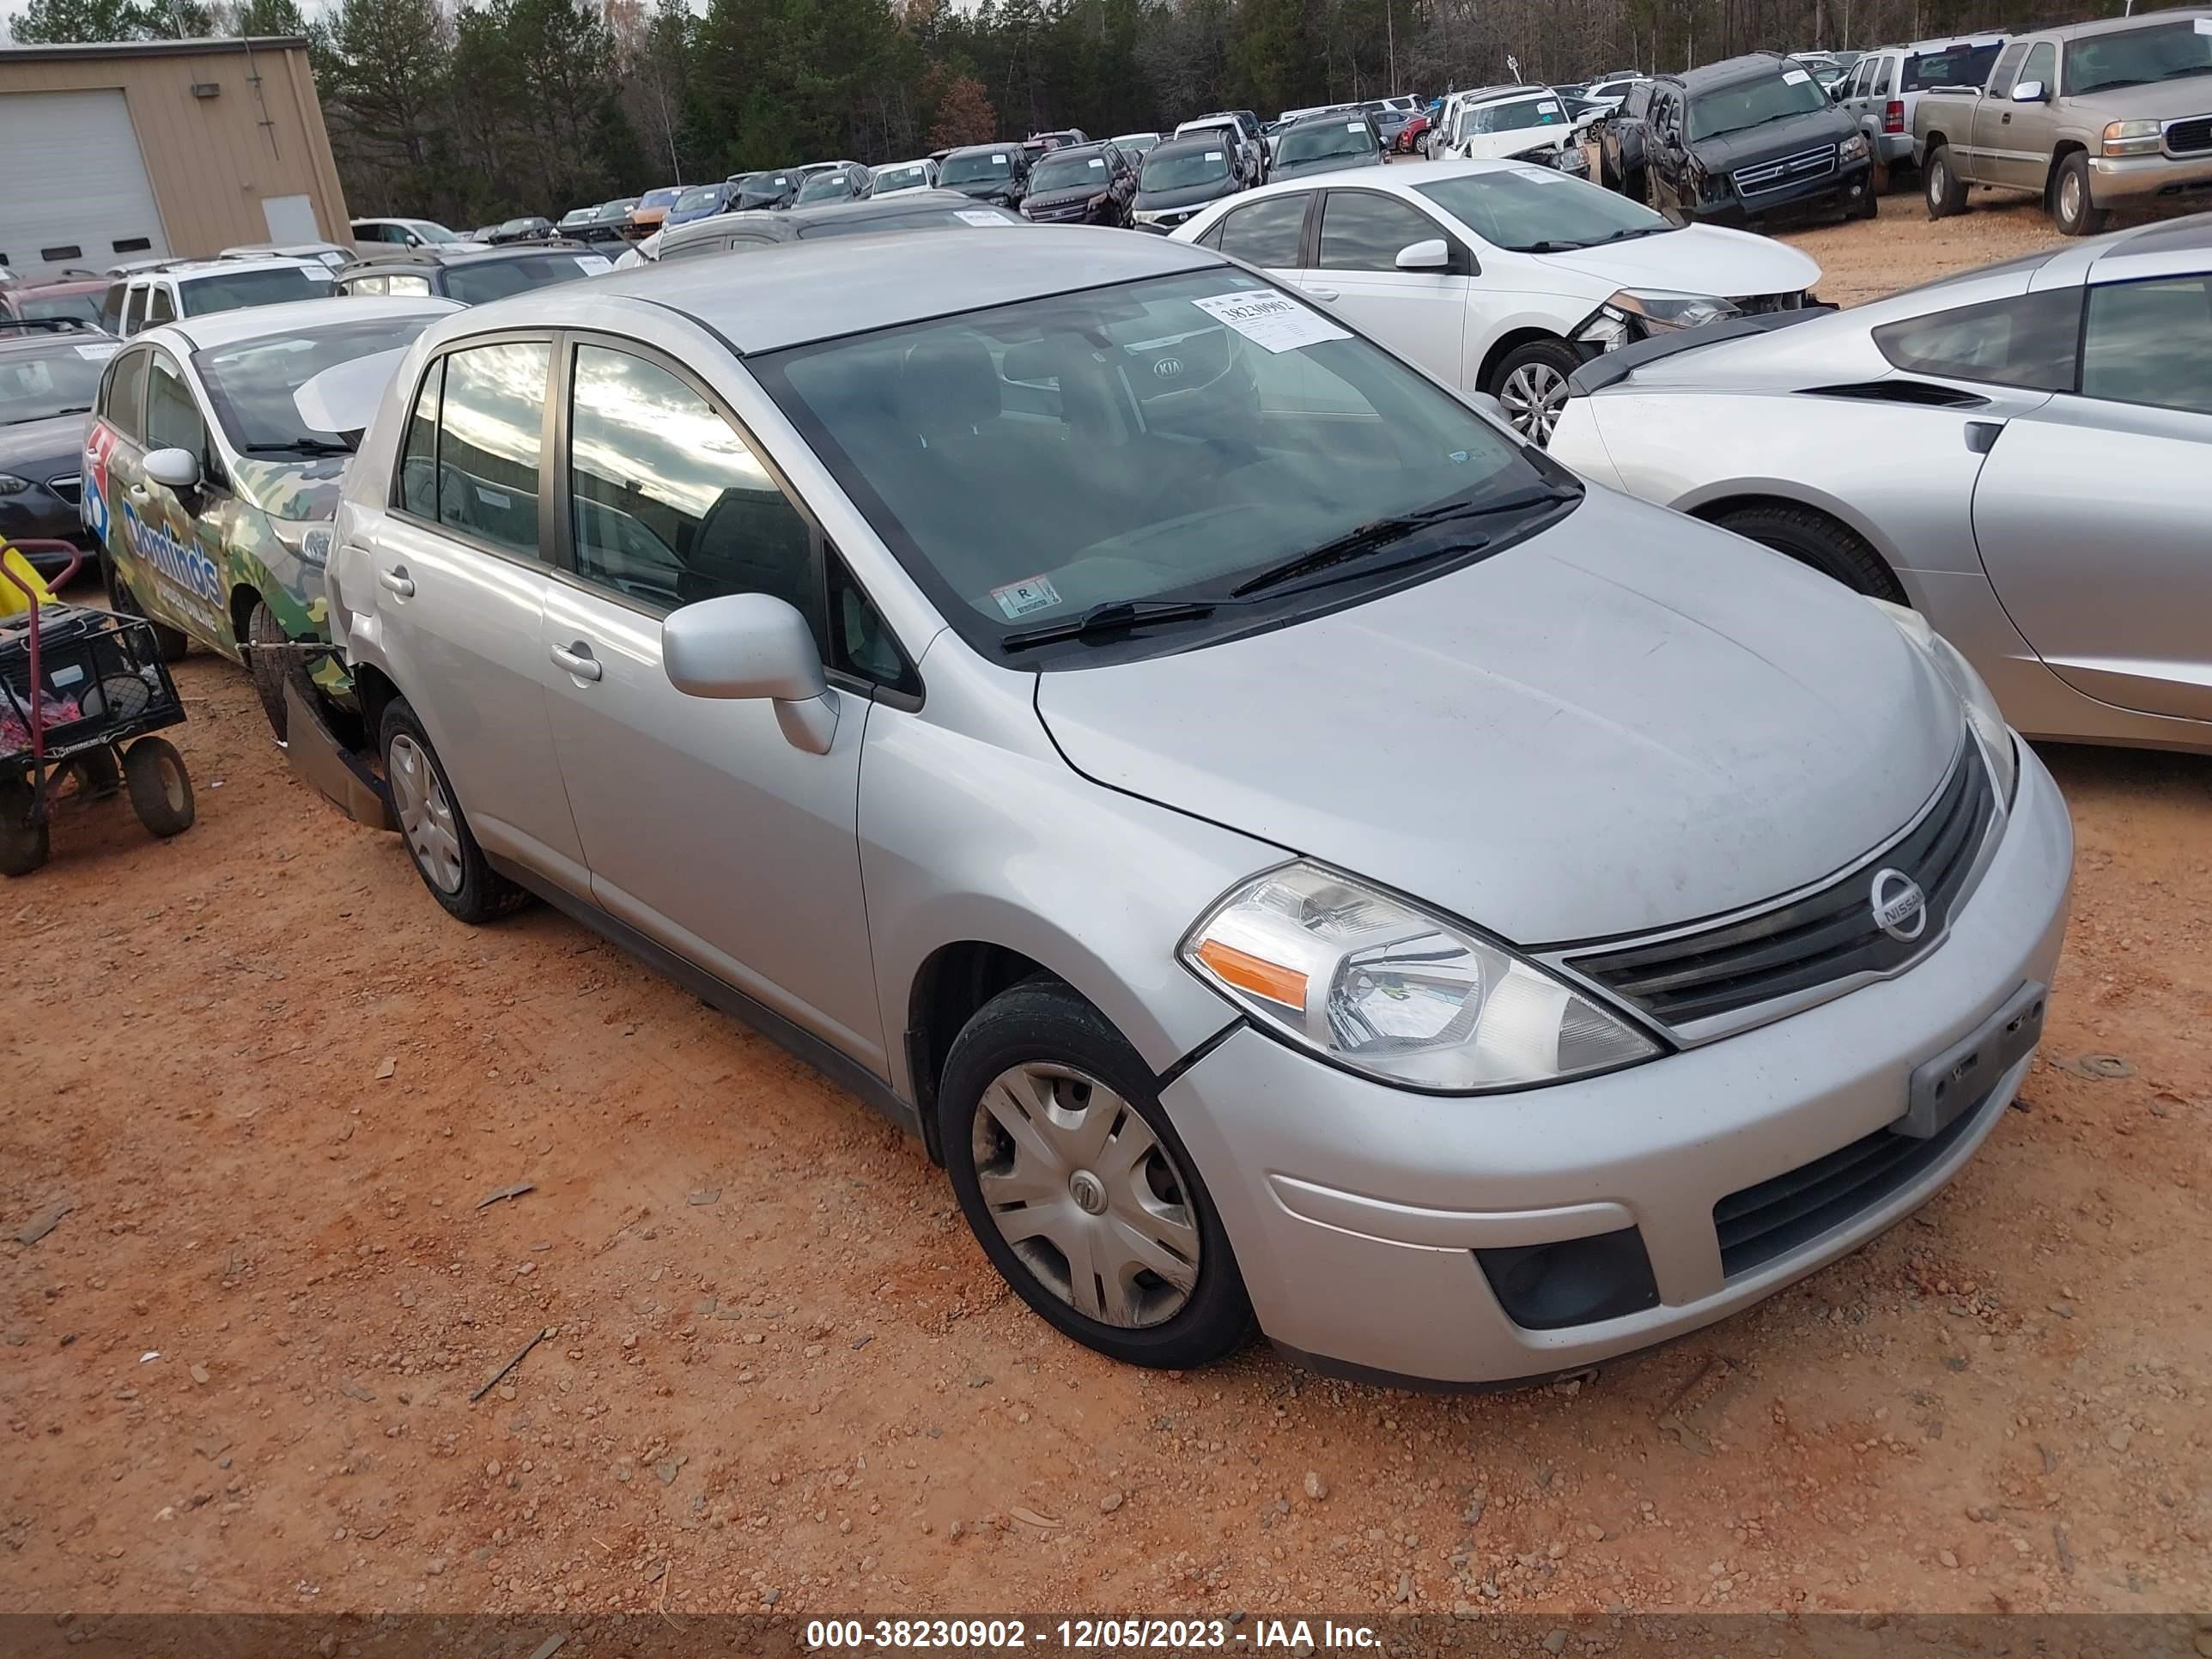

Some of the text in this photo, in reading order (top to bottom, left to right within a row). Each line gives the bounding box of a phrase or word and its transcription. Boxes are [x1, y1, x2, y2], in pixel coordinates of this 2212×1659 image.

[1221, 301, 1296, 321] 38230902
[1159, 361, 1180, 376] KIA
[123, 498, 223, 610] Domino's
[1018, 589, 1032, 599] R
